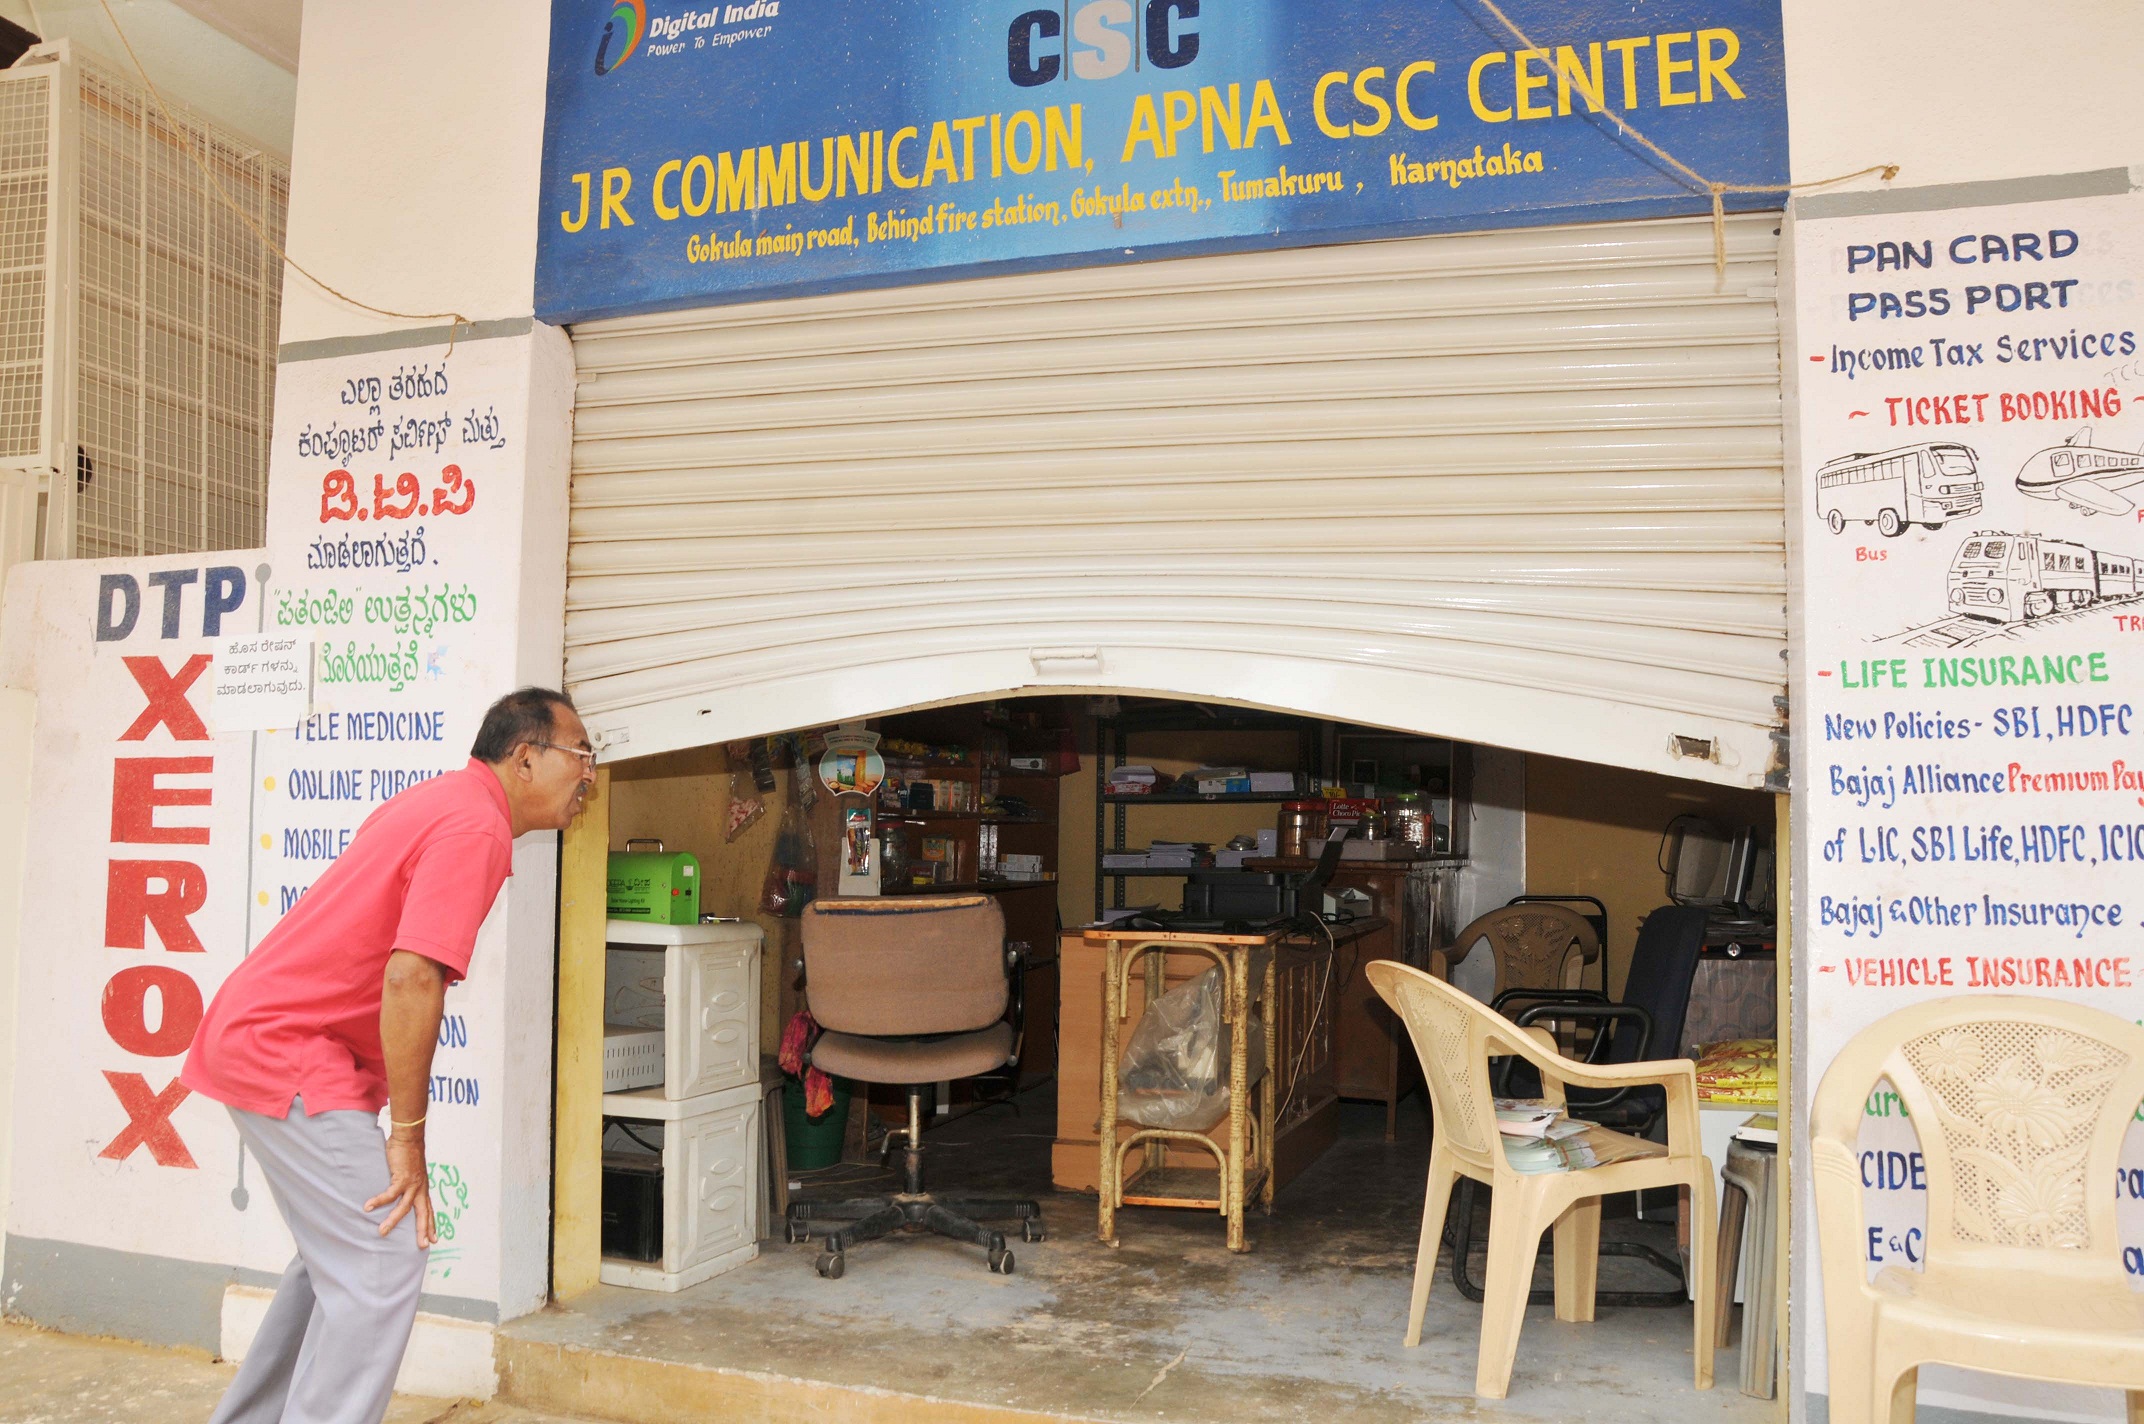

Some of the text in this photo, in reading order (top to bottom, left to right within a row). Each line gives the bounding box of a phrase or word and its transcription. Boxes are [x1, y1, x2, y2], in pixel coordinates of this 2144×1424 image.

[649, 0, 780, 40] Digital India
[647, 25, 772, 57] Power To Empower
[652, 103, 1094, 221] COMMUNICATION,
[1121, 79, 1291, 163] APNA
[1312, 61, 1439, 139] CSC
[1467, 27, 1746, 122] CENTER
[686, 229, 752, 264] Gokula
[756, 223, 803, 256] main
[807, 215, 859, 249] road,
[867, 203, 934, 244] Behind
[936, 202, 977, 234] fire
[982, 193, 1068, 227] station,
[1071, 186, 1145, 219] Gokula
[1389, 143, 1544, 189] Karnataka
[1847, 240, 1934, 273] PAN
[1949, 229, 2079, 264] CARD
[1848, 288, 1951, 322] PASS
[1830, 328, 2136, 380] Income Tax Services
[341, 363, 448, 415] ಎಲ್ಲಾ ತರಹದ
[1884, 387, 2121, 427] TICKET BOOKING
[462, 406, 506, 450] ಮತ್ತು
[1855, 547, 1888, 562] Bus
[95, 565, 247, 642] DTP
[2113, 615, 2144, 632] TR
[229, 641, 258, 655] ಹೊಸ
[1840, 652, 2109, 688] LIFE INSURANCE
[347, 711, 444, 742] MEDICINE
[1824, 713, 1877, 741] New
[288, 768, 363, 800] ONLINE
[1829, 764, 1896, 809] Bajaj
[1902, 763, 2006, 794] Alliance
[2007, 762, 2109, 793] Premium
[283, 827, 350, 860] MOBILE
[1823, 827, 1847, 863] of
[1911, 825, 1955, 863] SBI
[97, 653, 214, 1171] XEROX
[1820, 895, 1882, 939] Bajaj
[1909, 896, 1977, 927] Other
[1982, 894, 2123, 939] Insurance
[1845, 957, 2132, 988] VEHICLE INSURANCE
[1858, 1150, 1927, 1190] CIDE
